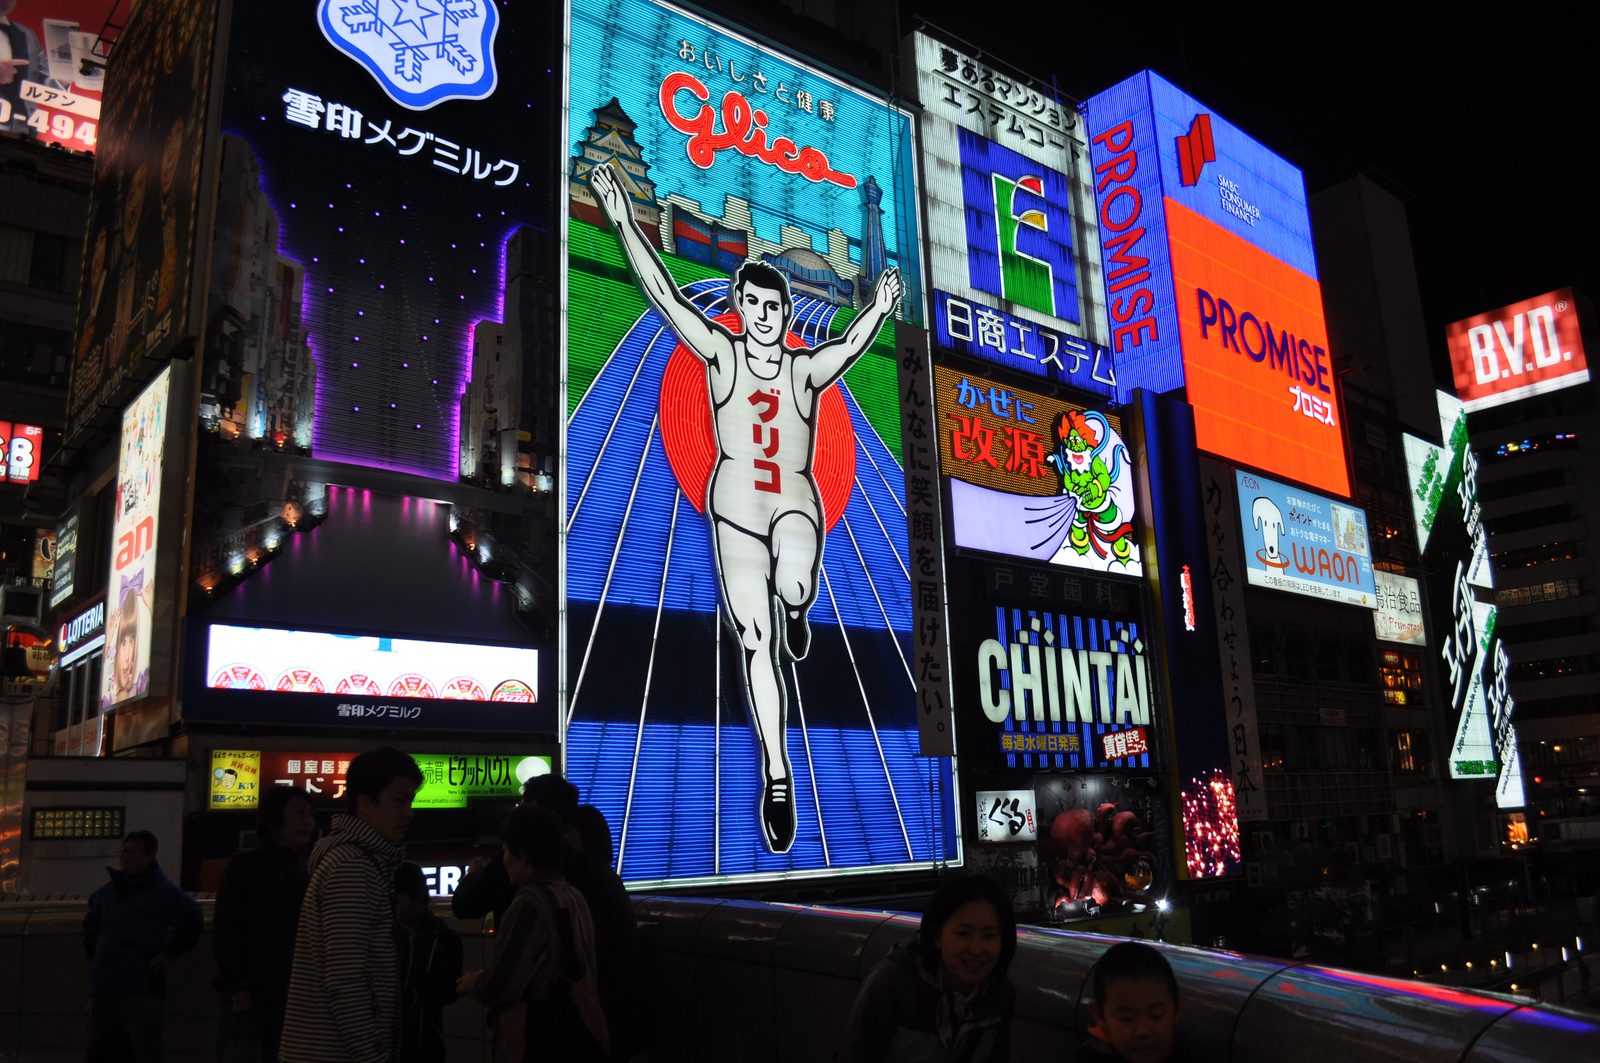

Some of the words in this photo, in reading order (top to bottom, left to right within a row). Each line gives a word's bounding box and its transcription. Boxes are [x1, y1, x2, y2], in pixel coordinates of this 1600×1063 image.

[26, 86, 76, 107] ルアン
[679, 39, 834, 122] おいしさと健康
[940, 48, 1077, 131] 夢あるマンション
[282, 88, 520, 186] 雪印メグミルク
[659, 71, 857, 189] Glico
[943, 82, 1081, 163] エステムコート
[1218, 174, 1240, 196] SMBC
[1219, 186, 1261, 220] CONSUMER
[1221, 199, 1255, 227] FINANCE
[1092, 119, 1159, 353] PROMISE
[947, 298, 1117, 387] 日商エステム
[1196, 288, 1331, 394] PROMISE
[1468, 305, 1571, 386] B.V.D.
[956, 378, 1036, 425] かぜに
[1289, 386, 1335, 427] プロミス
[747, 388, 781, 494] グリコ
[949, 413, 1048, 479] 改源
[115, 515, 154, 572] an
[901, 346, 946, 735] みんなに笑顔を届けたい。
[1292, 542, 1360, 585] WAON
[67, 602, 104, 643] LOTTERIA
[1206, 476, 1258, 804] 力を合わせよう日本
[978, 618, 1150, 725] CHINTAI
[337, 703, 422, 720] 雪印メグミルク
[1001, 733, 1080, 752] 毎週水曜日発売
[448, 756, 512, 786] ピタットハウス
[988, 797, 1026, 836] くくる
